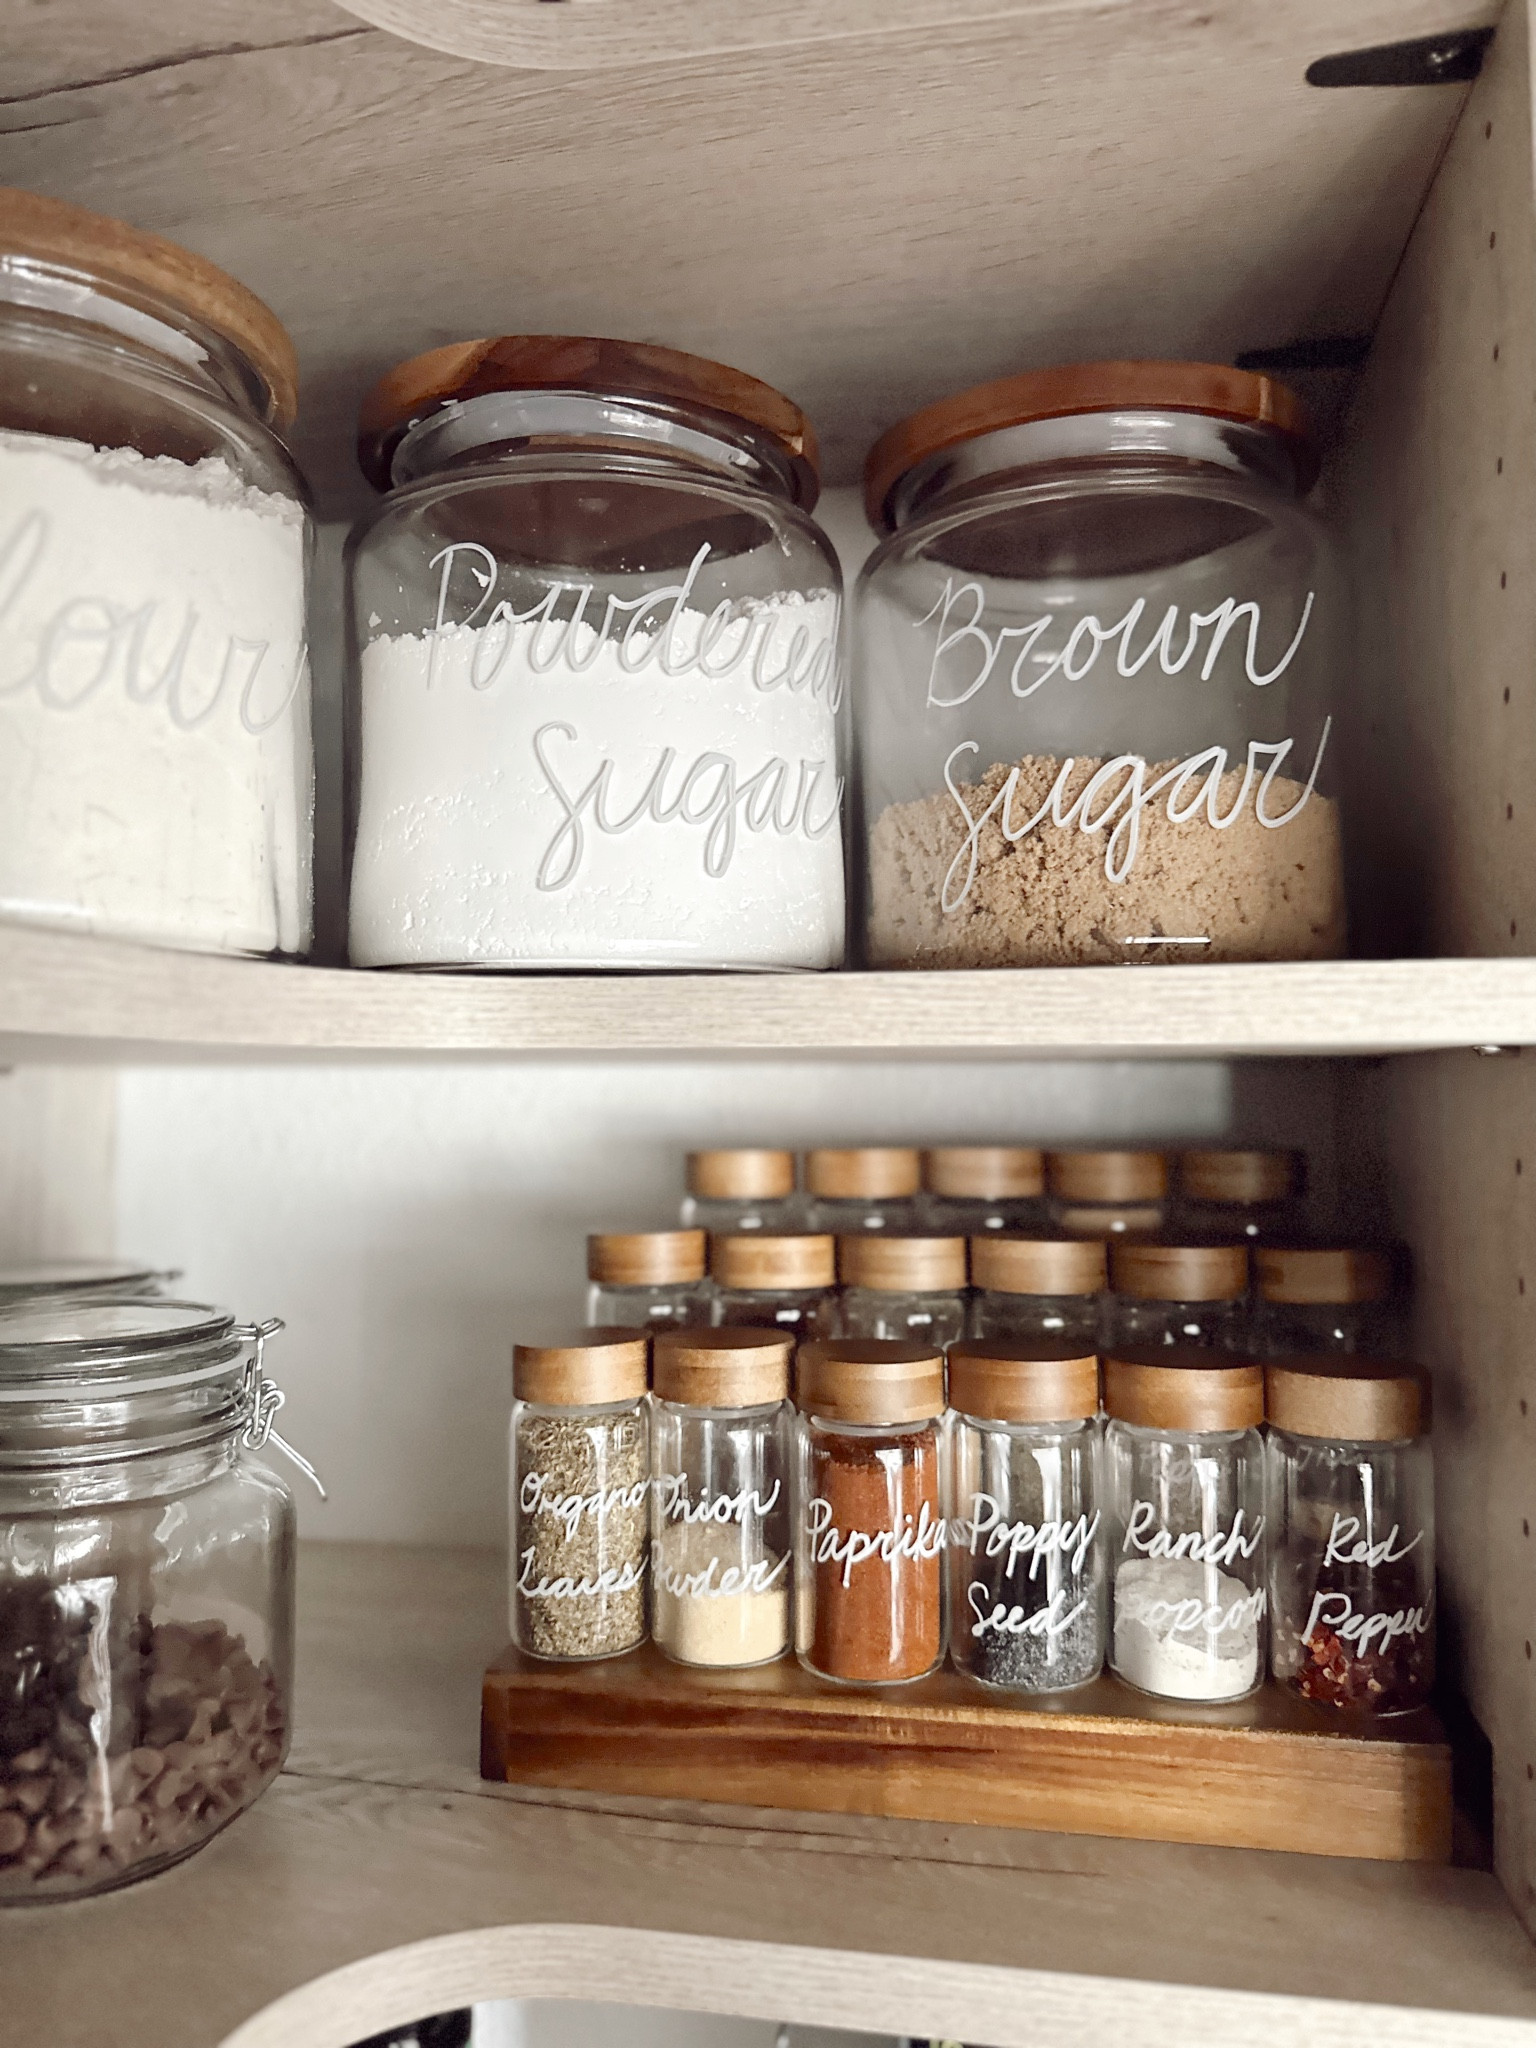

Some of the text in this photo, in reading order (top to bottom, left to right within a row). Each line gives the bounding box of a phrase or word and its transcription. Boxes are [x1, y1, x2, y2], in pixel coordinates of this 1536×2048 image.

[0, 507, 310, 736] lour
[428, 541, 846, 714] Powdered
[912, 576, 1315, 709] Brown
[531, 721, 846, 893] Sugar
[941, 714, 1333, 914] Sugar
[652, 1472, 781, 1523] Onion
[966, 1492, 1101, 1581] Poppy
[1122, 1499, 1266, 1566] Ranch
[1323, 1511, 1425, 1568] Red
[516, 1544, 650, 1598] Leaves
[805, 1498, 948, 1588] Paprika
[967, 1580, 1088, 1638] Seed
